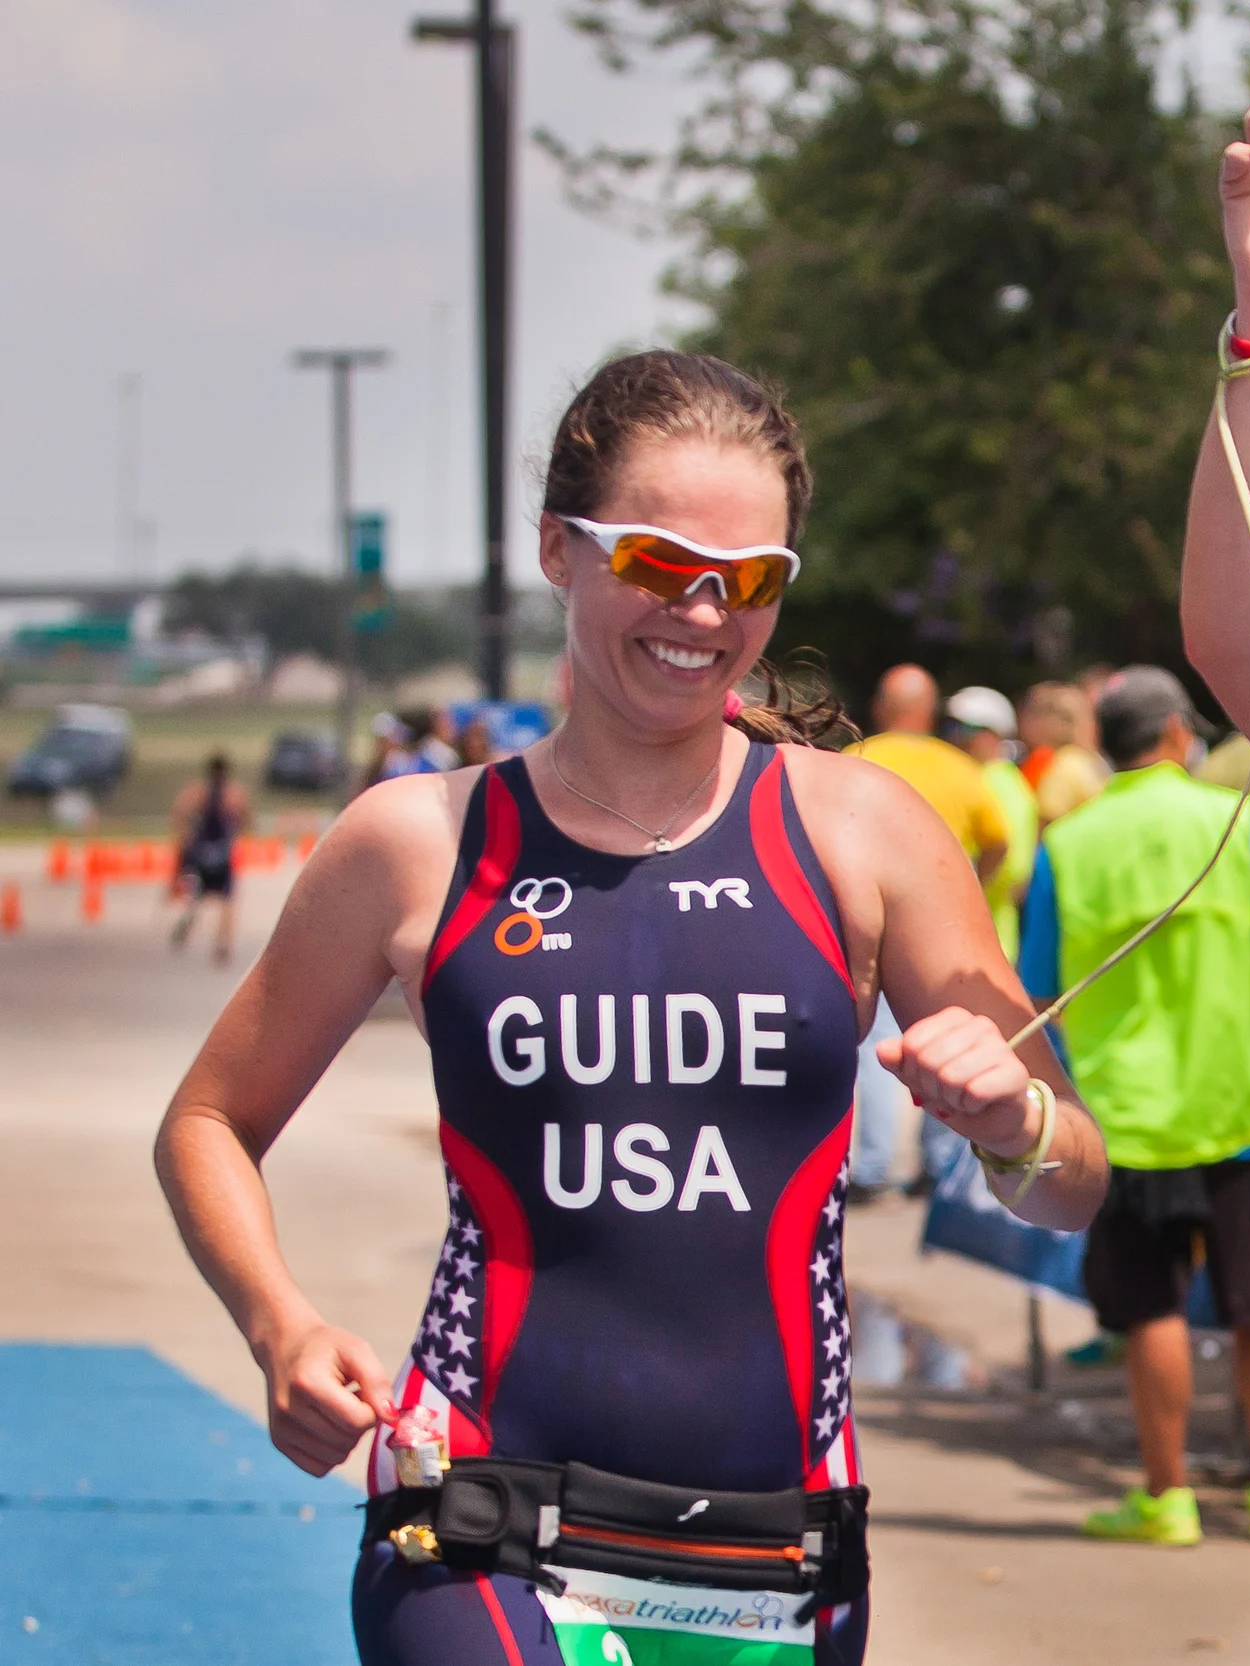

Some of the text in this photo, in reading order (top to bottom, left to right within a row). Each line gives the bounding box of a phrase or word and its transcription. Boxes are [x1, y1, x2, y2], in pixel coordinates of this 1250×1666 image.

[669, 877, 754, 912] TYR
[541, 932, 573, 951] ITU
[487, 992, 788, 1088] GUIDE
[543, 1121, 752, 1212] USA
